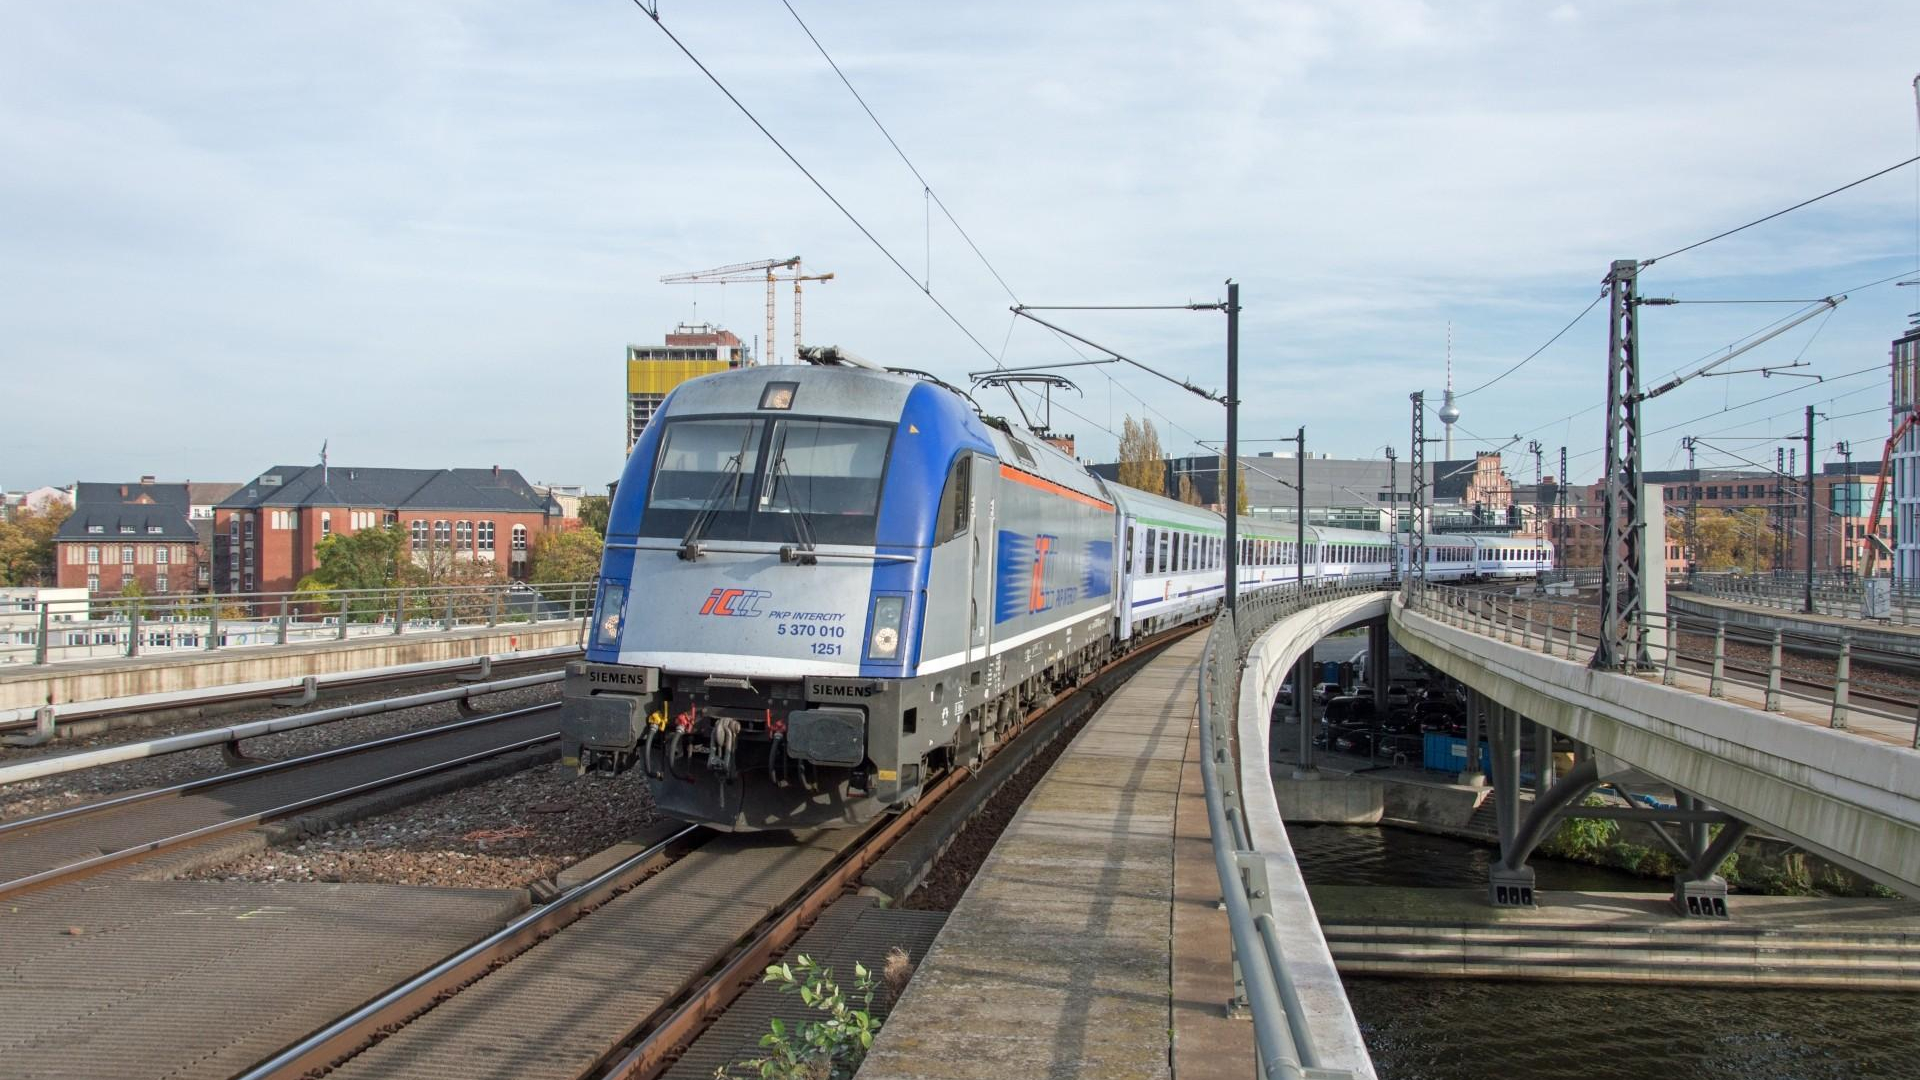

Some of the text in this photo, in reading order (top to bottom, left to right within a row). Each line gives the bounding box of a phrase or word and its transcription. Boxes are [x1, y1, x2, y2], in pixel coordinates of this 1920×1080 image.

[768, 610, 846, 621] PKP INTERCITY
[777, 623, 845, 638] 5 370 010
[810, 643, 842, 655] 1251
[589, 671, 644, 685] SIEMENS
[812, 683, 872, 698] SIEMENS
